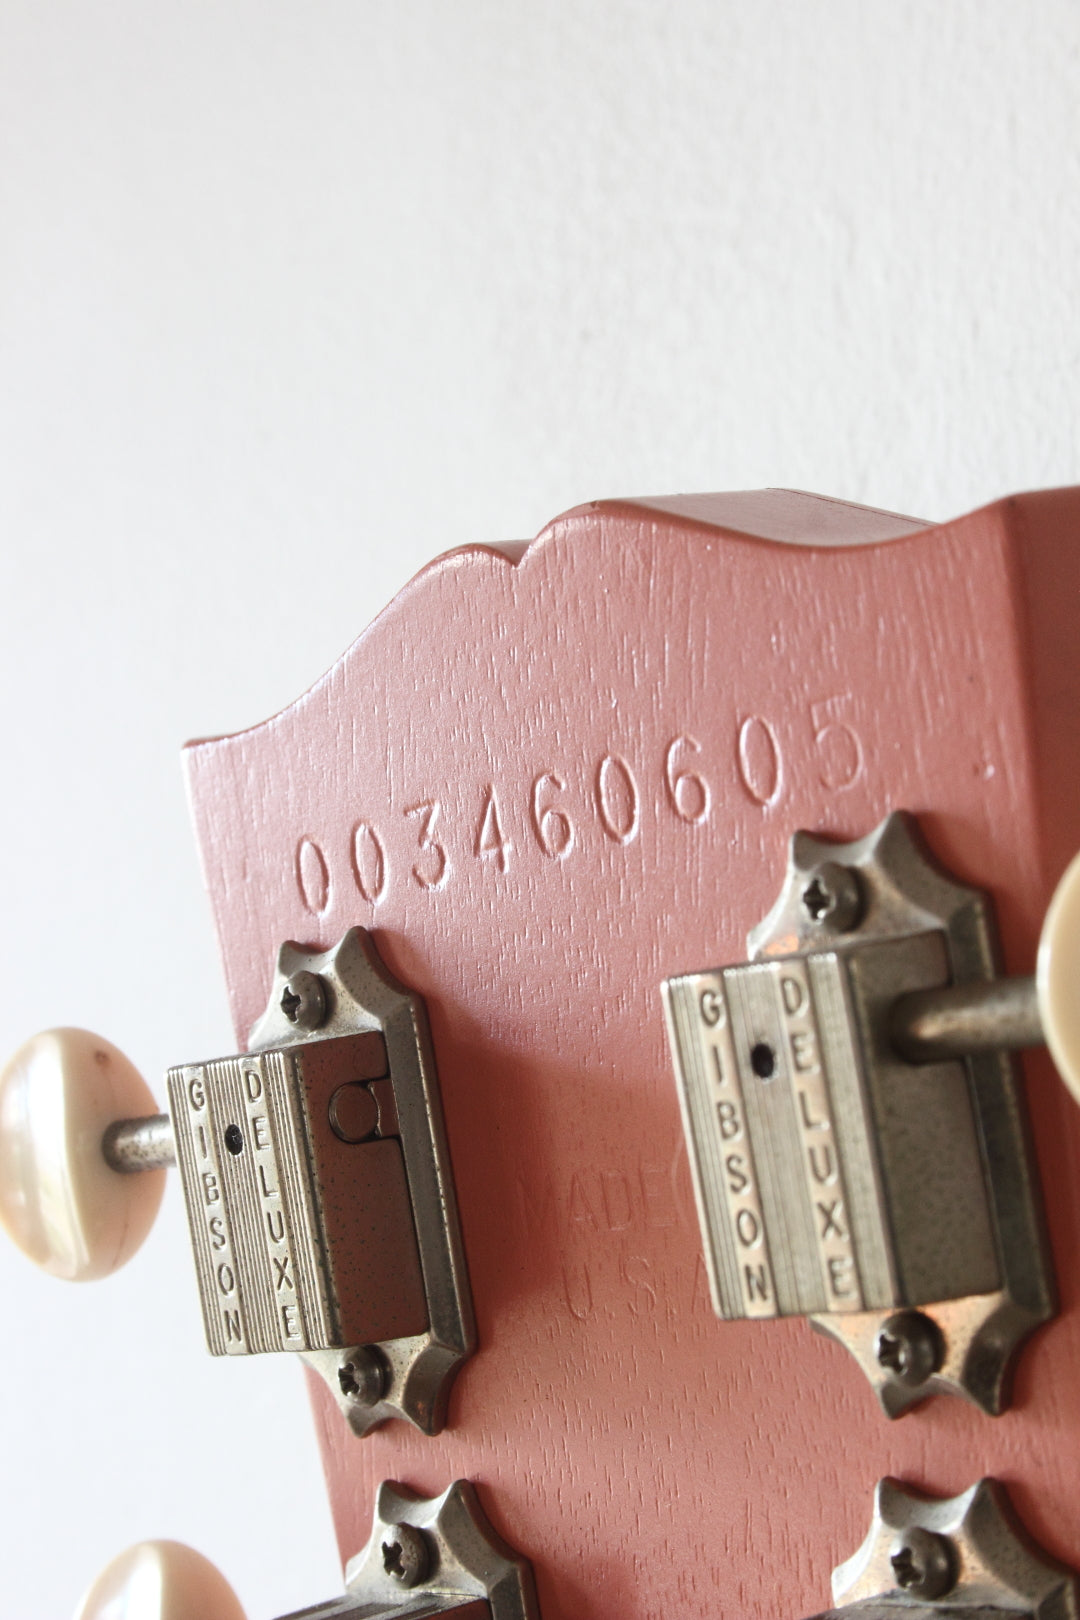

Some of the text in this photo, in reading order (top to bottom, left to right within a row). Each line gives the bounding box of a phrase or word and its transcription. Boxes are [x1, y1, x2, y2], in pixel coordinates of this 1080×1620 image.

[296, 694, 864, 917] 003460605
[188, 1078, 244, 1343] GIBSON
[244, 1069, 303, 1340] DELUXE
[516, 1167, 675, 1232] MADE
[698, 988, 769, 1301] GIBSON
[780, 977, 854, 1299] DELUXE
